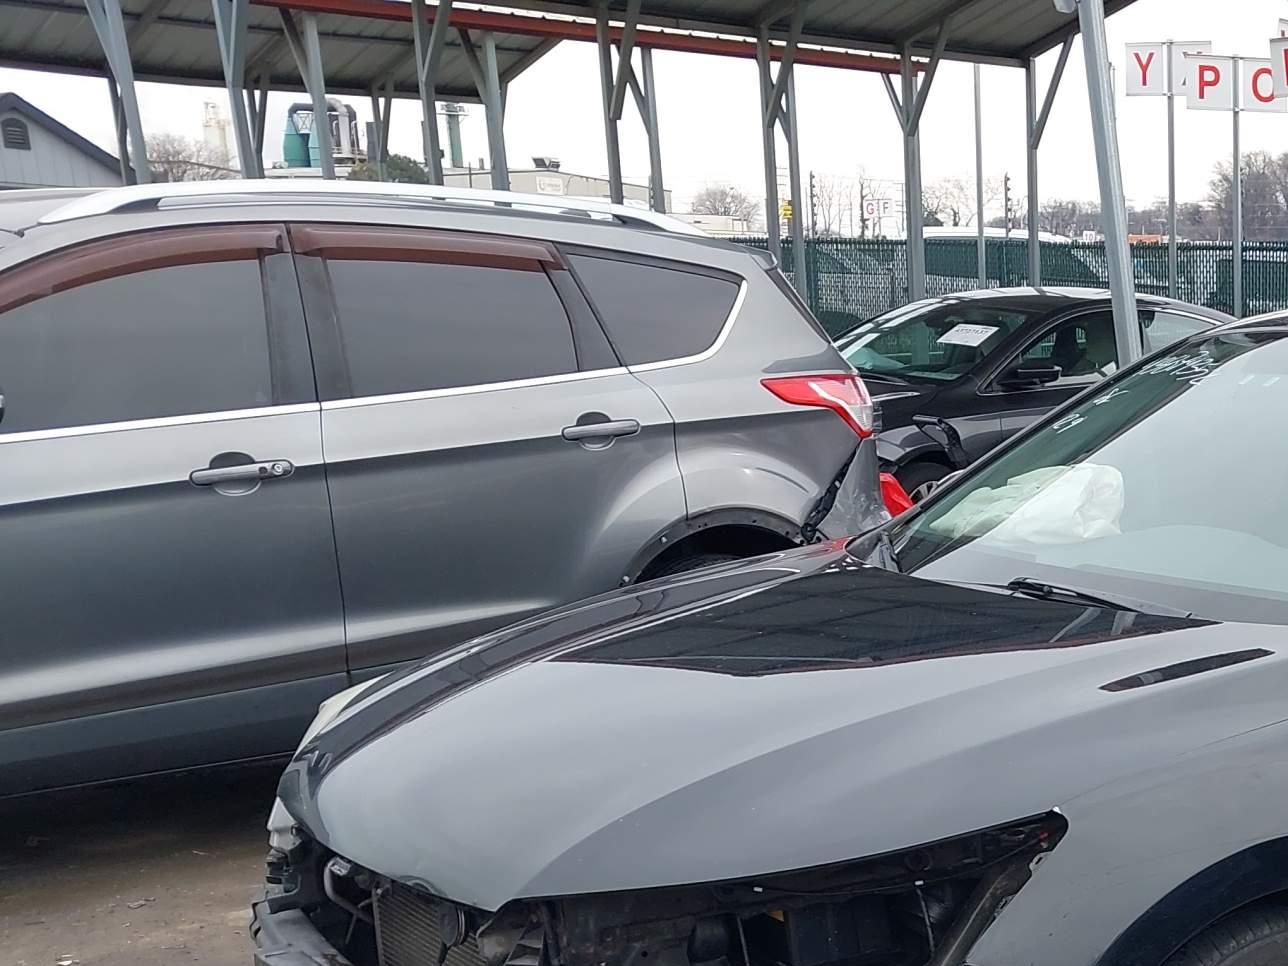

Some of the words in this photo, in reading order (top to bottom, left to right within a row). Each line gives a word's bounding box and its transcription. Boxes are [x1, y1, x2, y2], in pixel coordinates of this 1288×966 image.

[1134, 52, 1155, 87] Y
[1198, 65, 1221, 99] P
[865, 202, 875, 215] G
